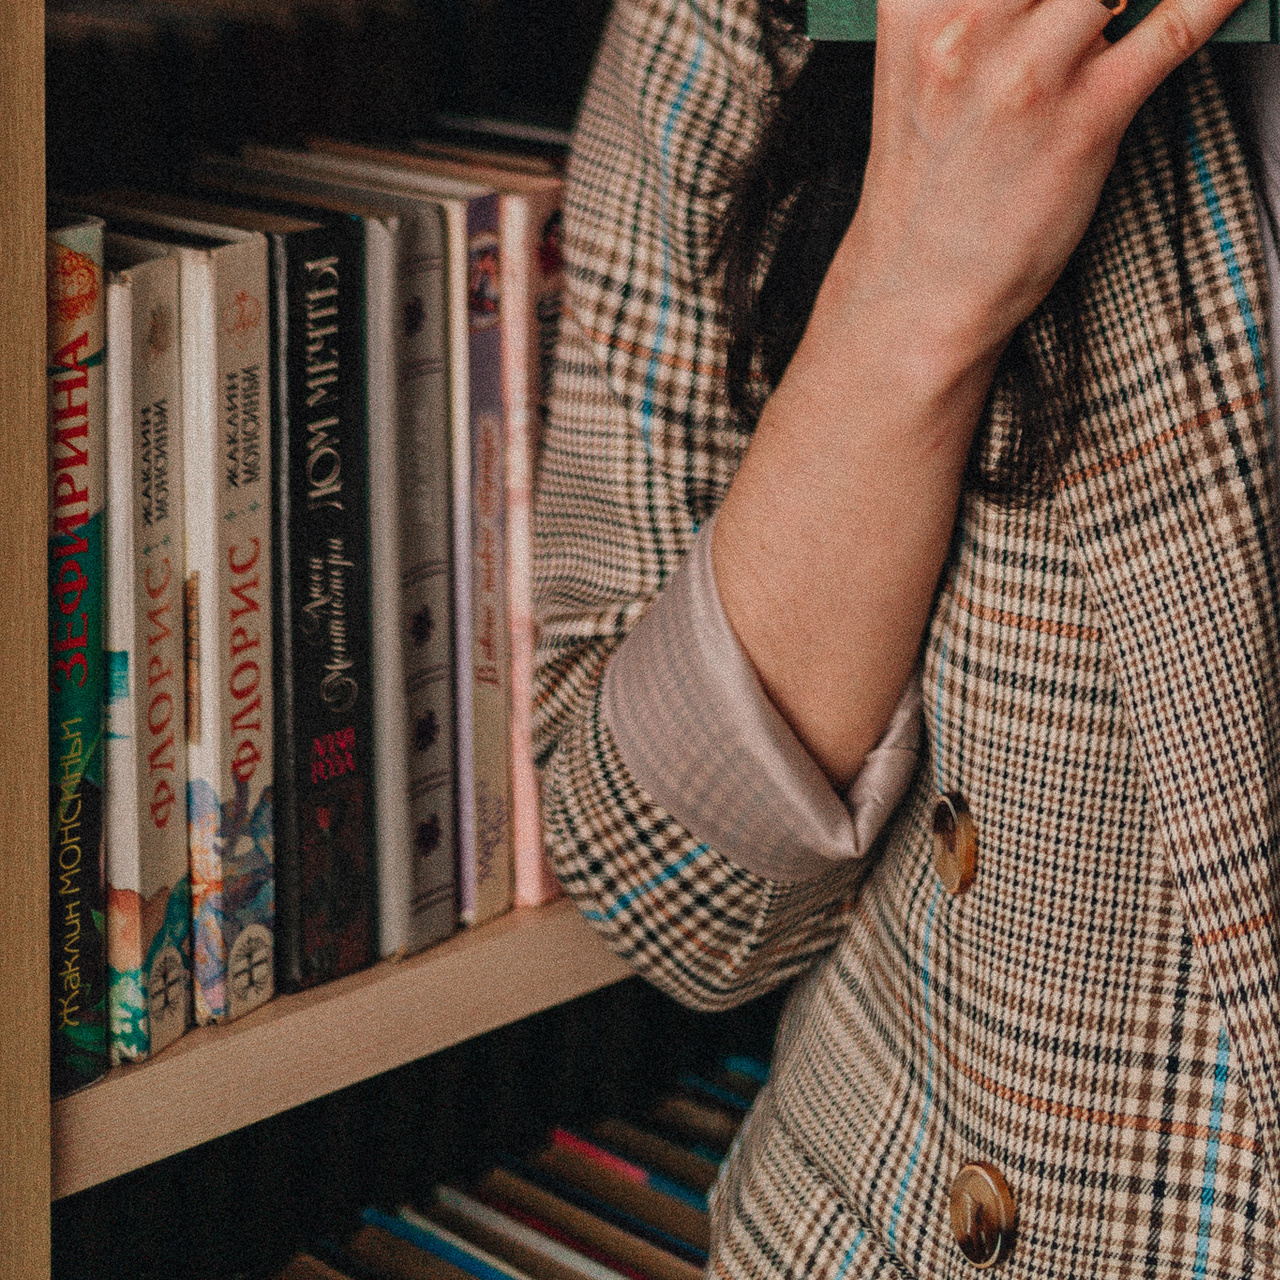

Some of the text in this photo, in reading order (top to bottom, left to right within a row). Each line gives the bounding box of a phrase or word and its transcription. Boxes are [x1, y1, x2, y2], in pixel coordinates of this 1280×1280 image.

[140, 406, 154, 527] ЖАКЛИН
[153, 397, 169, 522] МОНСИНЬИ
[225, 372, 239, 490] ЖАКЛИН
[241, 364, 260, 485] МОНСИНЬИ
[304, 255, 345, 510] ДОМ МЕЧТЫ
[52, 329, 90, 690] ЗЕФИРИНА
[142, 555, 176, 831] ФЛОРИС
[227, 536, 262, 784] ФЛОРИС
